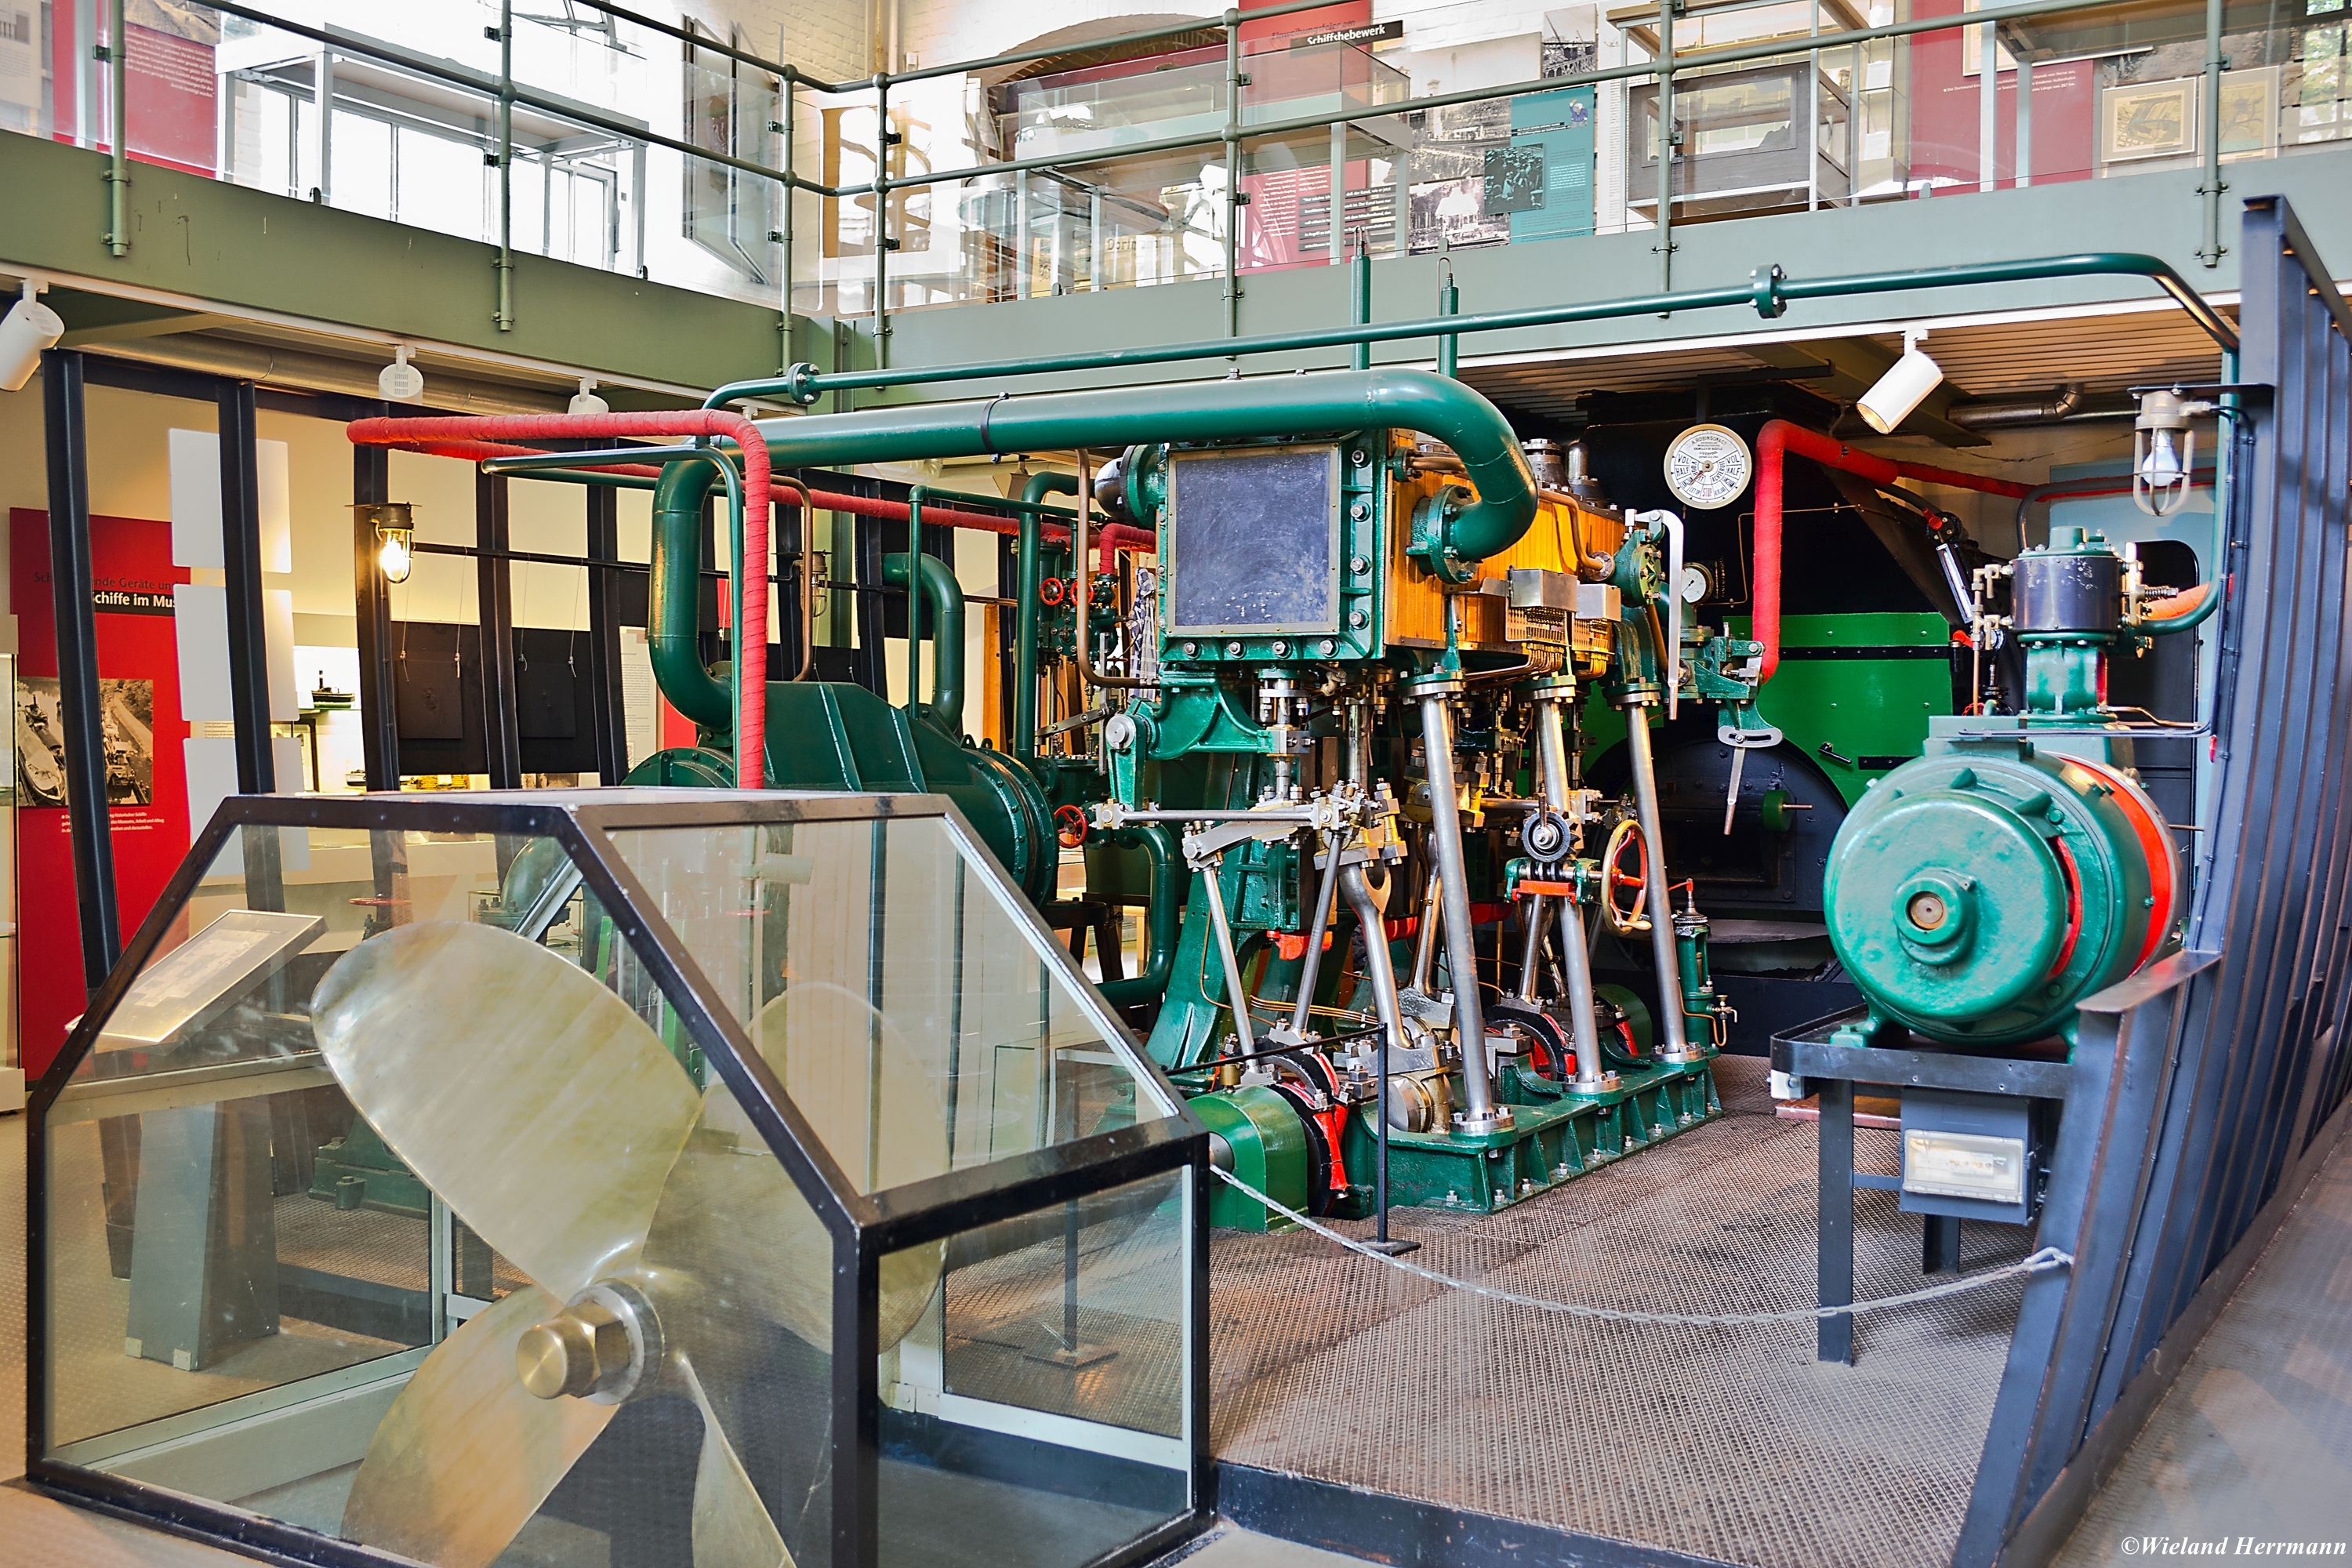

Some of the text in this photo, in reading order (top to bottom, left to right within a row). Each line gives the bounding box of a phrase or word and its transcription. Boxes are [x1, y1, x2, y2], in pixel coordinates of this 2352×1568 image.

[1272, 22, 1340, 39] Einweihungsfeier
[1307, 24, 1385, 45] Schiffshebewerk
[1678, 453, 1690, 464] VOL
[1726, 454, 1740, 464] VOL
[1675, 466, 1689, 477] HALF
[1726, 467, 1740, 476] HALF
[1702, 488, 1712, 497] STOP
[119, 578, 154, 589] Geräte
[158, 581, 179, 590] un
[133, 593, 149, 607] im
